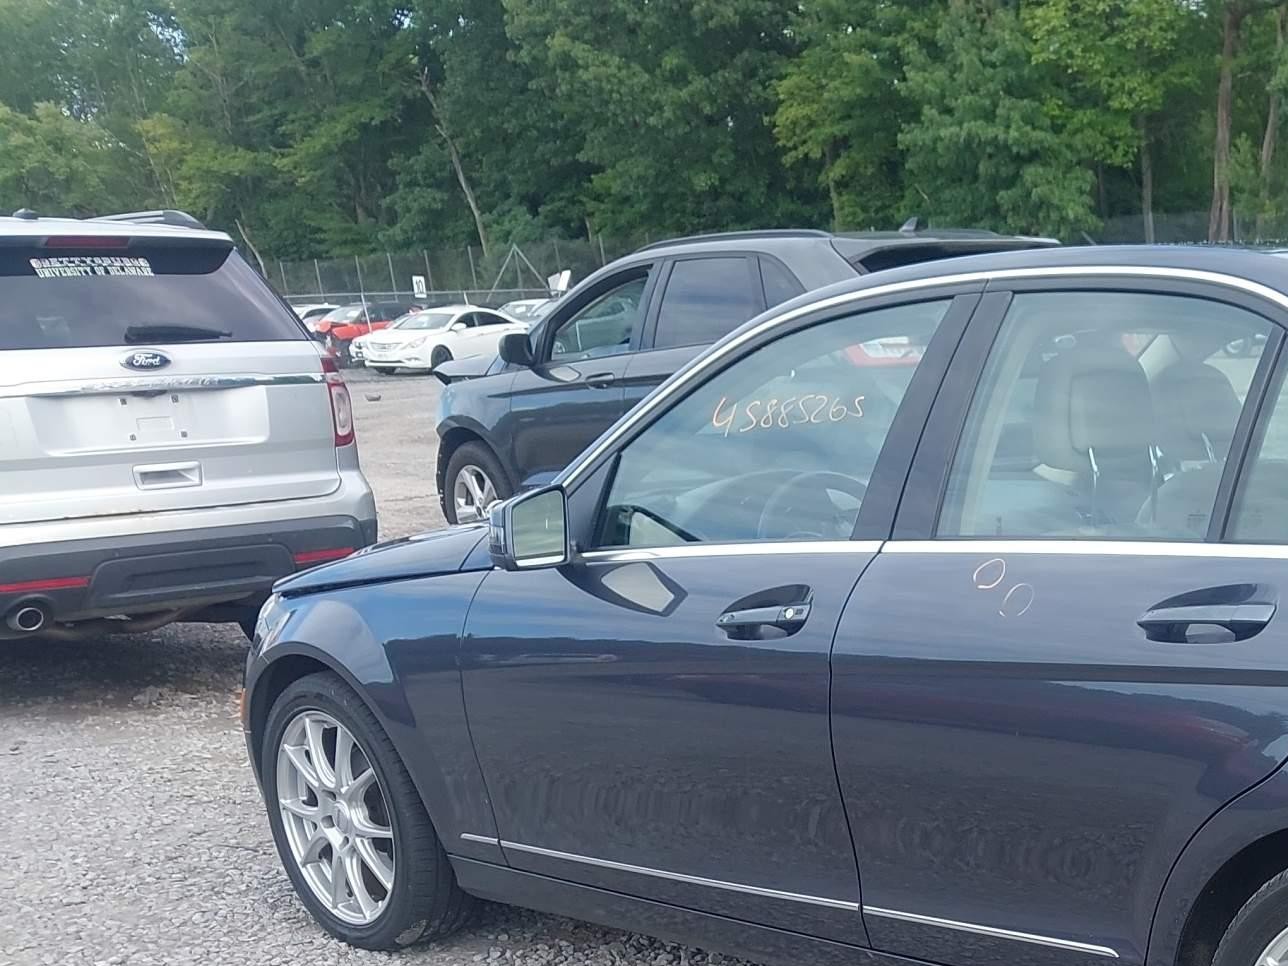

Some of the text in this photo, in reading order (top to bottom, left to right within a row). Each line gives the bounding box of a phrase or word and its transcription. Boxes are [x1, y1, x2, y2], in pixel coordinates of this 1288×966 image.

[36, 265, 155, 278] UNIVERSITY OF DELAWARE
[416, 279, 425, 295] 10
[132, 353, 161, 366] Ford
[712, 395, 866, 437] 45885265
